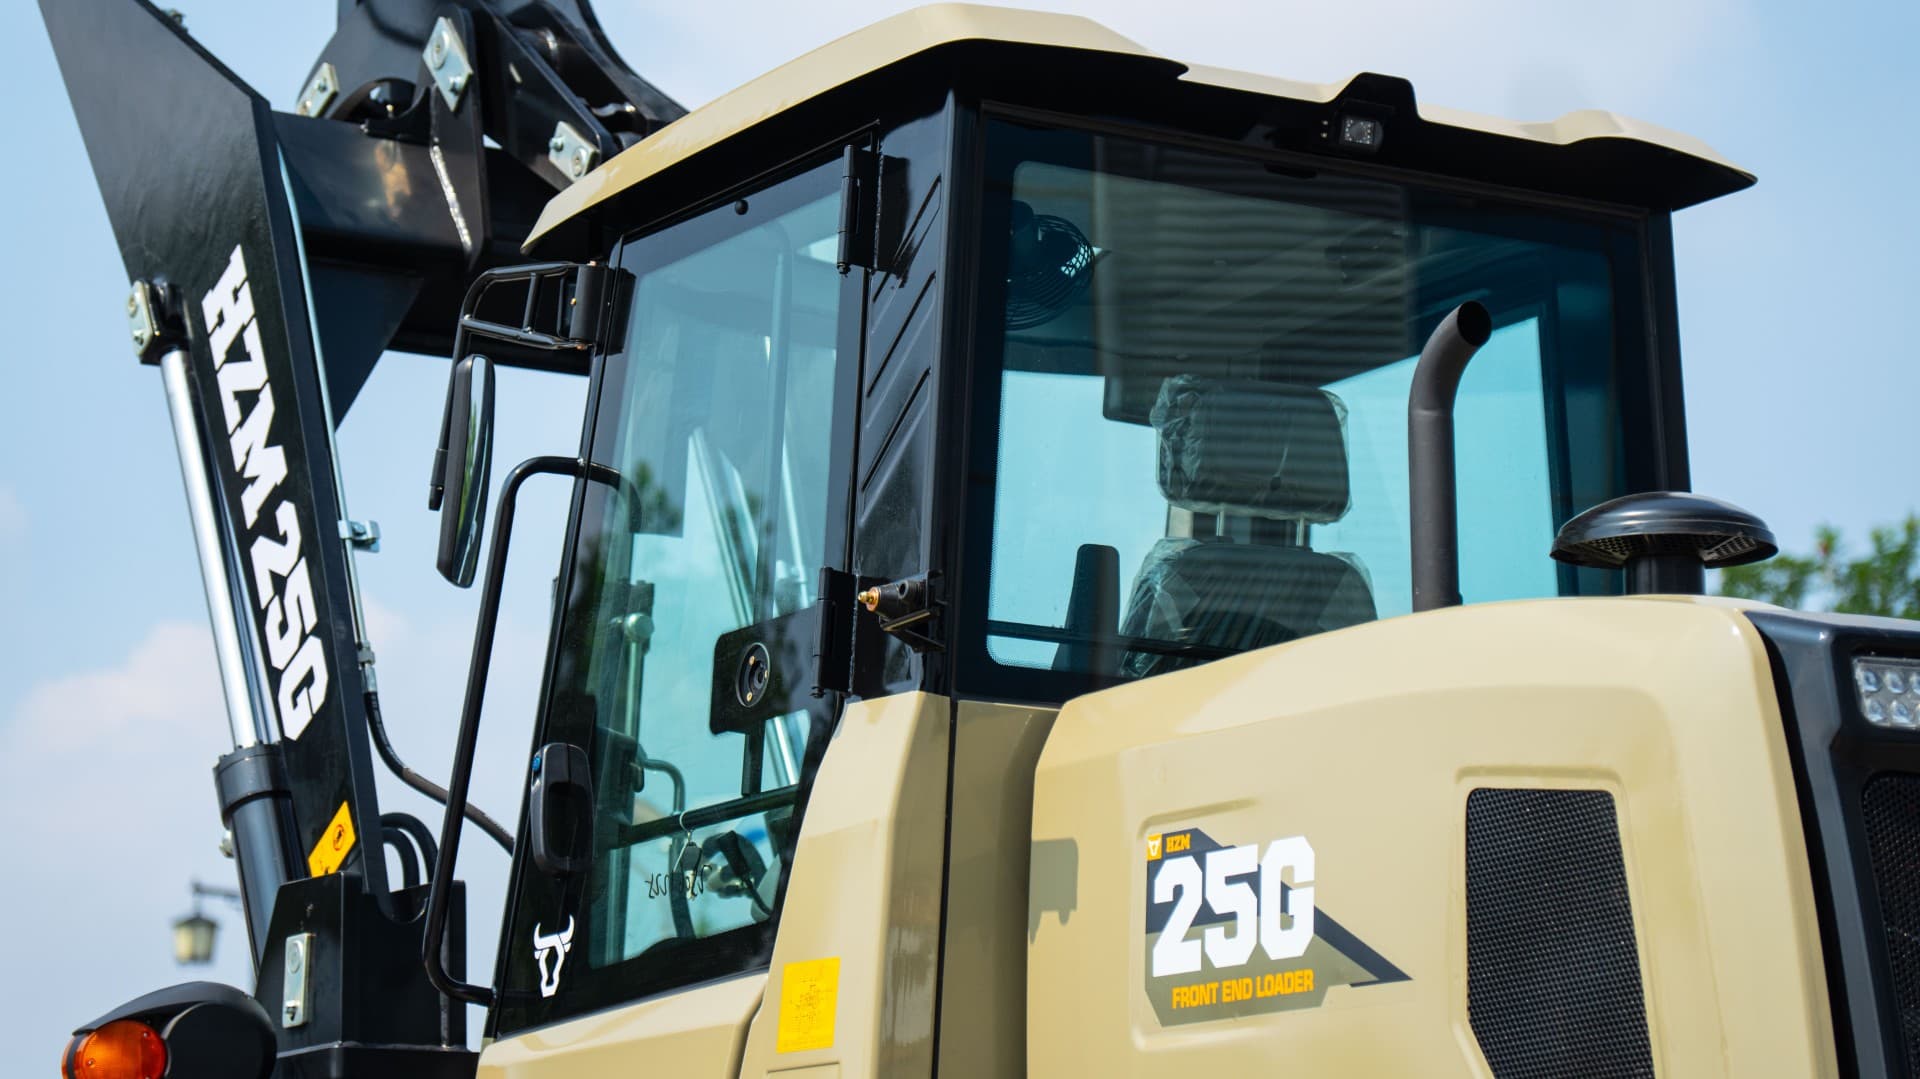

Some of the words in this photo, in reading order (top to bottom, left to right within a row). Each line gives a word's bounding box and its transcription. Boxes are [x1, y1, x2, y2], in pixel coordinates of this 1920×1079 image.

[1152, 836, 1315, 977] 25G
[1171, 982, 1220, 1009] FRONT
[1222, 977, 1253, 1003] END
[1256, 969, 1315, 998] LOADER
